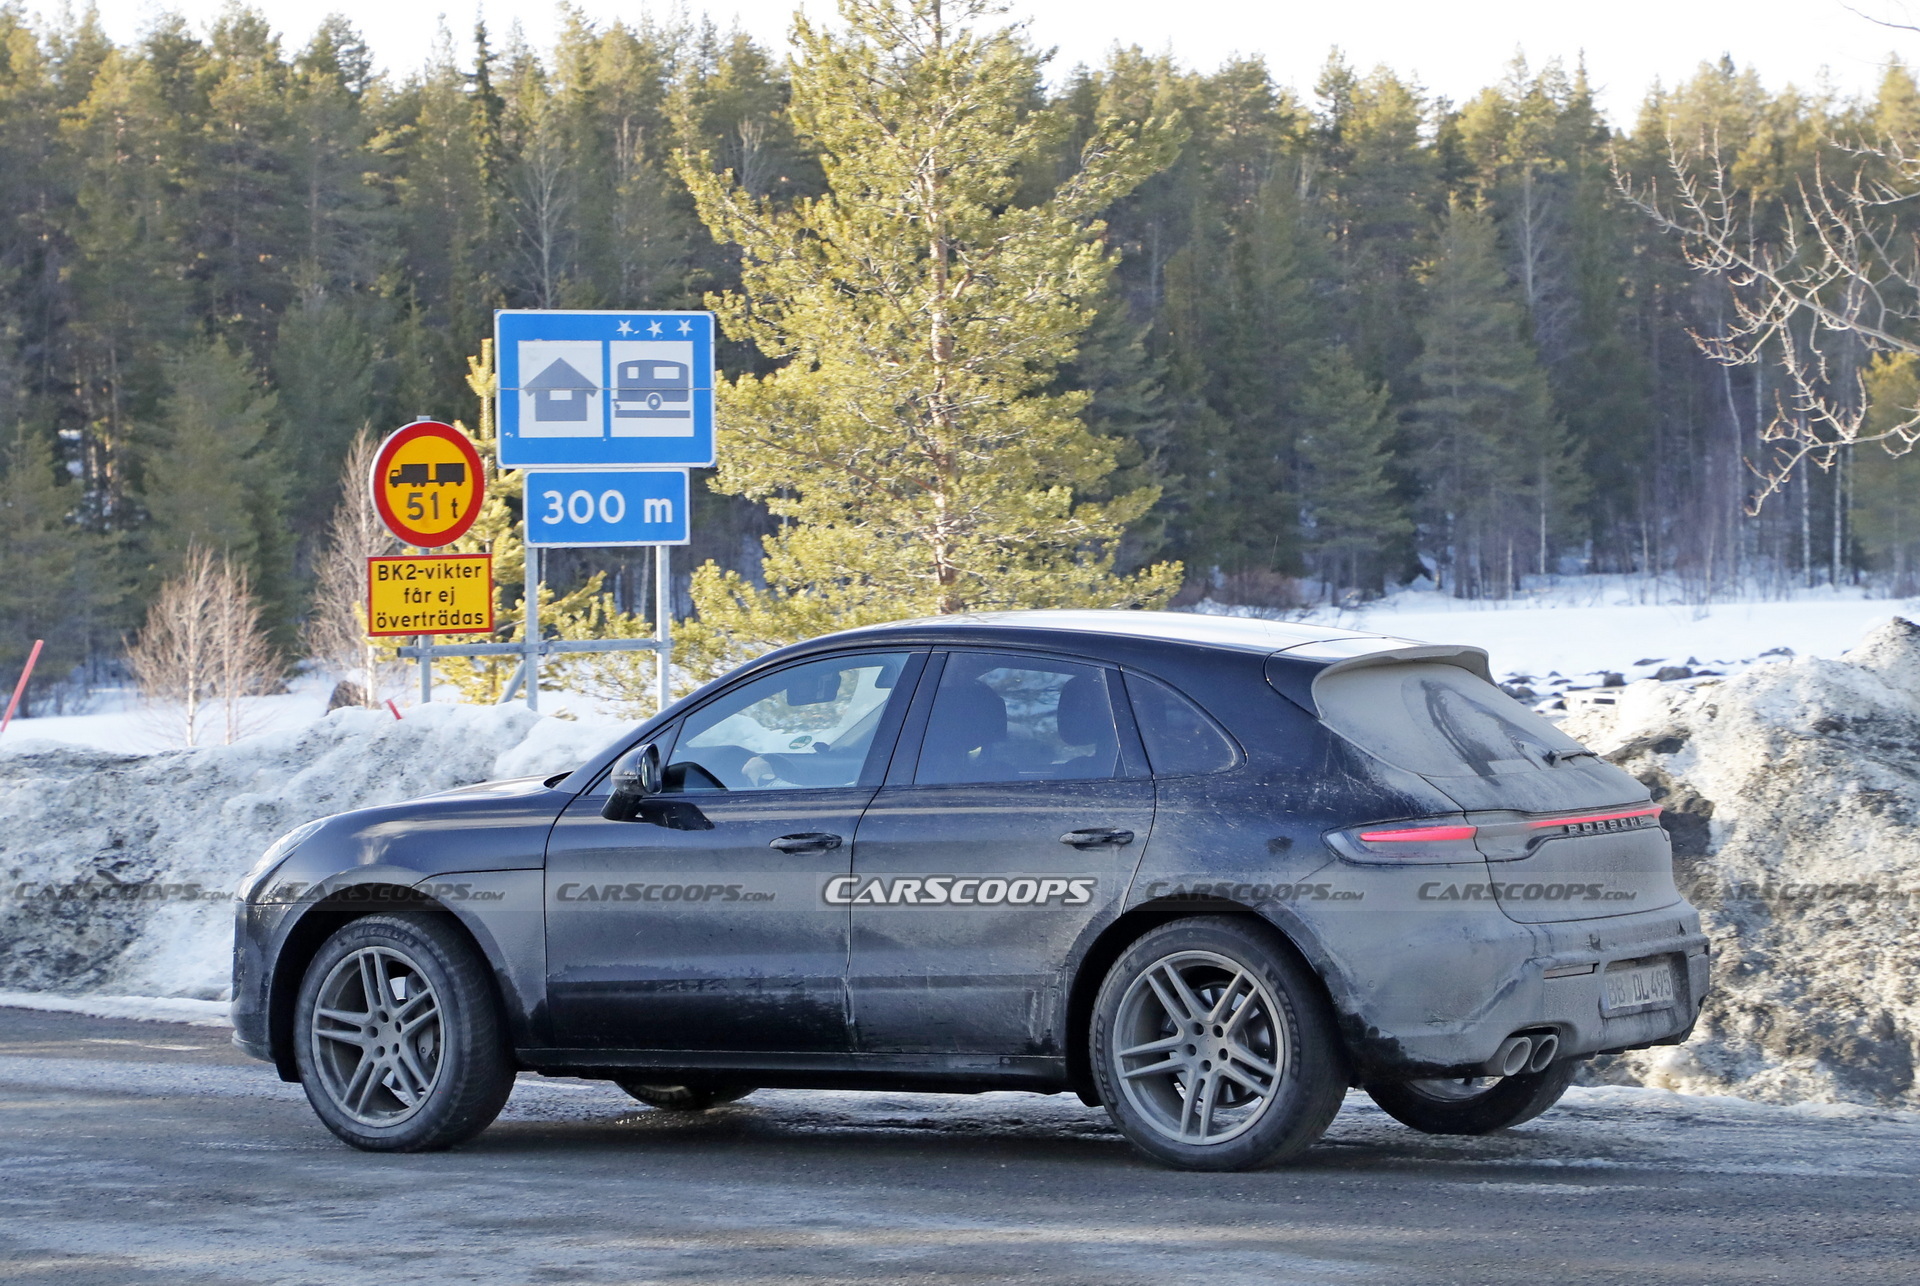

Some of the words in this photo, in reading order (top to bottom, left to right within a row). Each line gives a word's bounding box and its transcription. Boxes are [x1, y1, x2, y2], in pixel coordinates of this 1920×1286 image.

[406, 491, 439, 520] 51
[451, 497, 458, 519] t
[541, 489, 626, 525] 300
[643, 498, 673, 524] m
[377, 563, 482, 581] BK2-vikter
[404, 587, 432, 604] får
[438, 586, 455, 606] ej
[376, 611, 484, 629] överträdas
[1567, 816, 1647, 835] PORSCHE
[1632, 973, 1650, 1001] DL
[1651, 968, 1672, 998] 495
